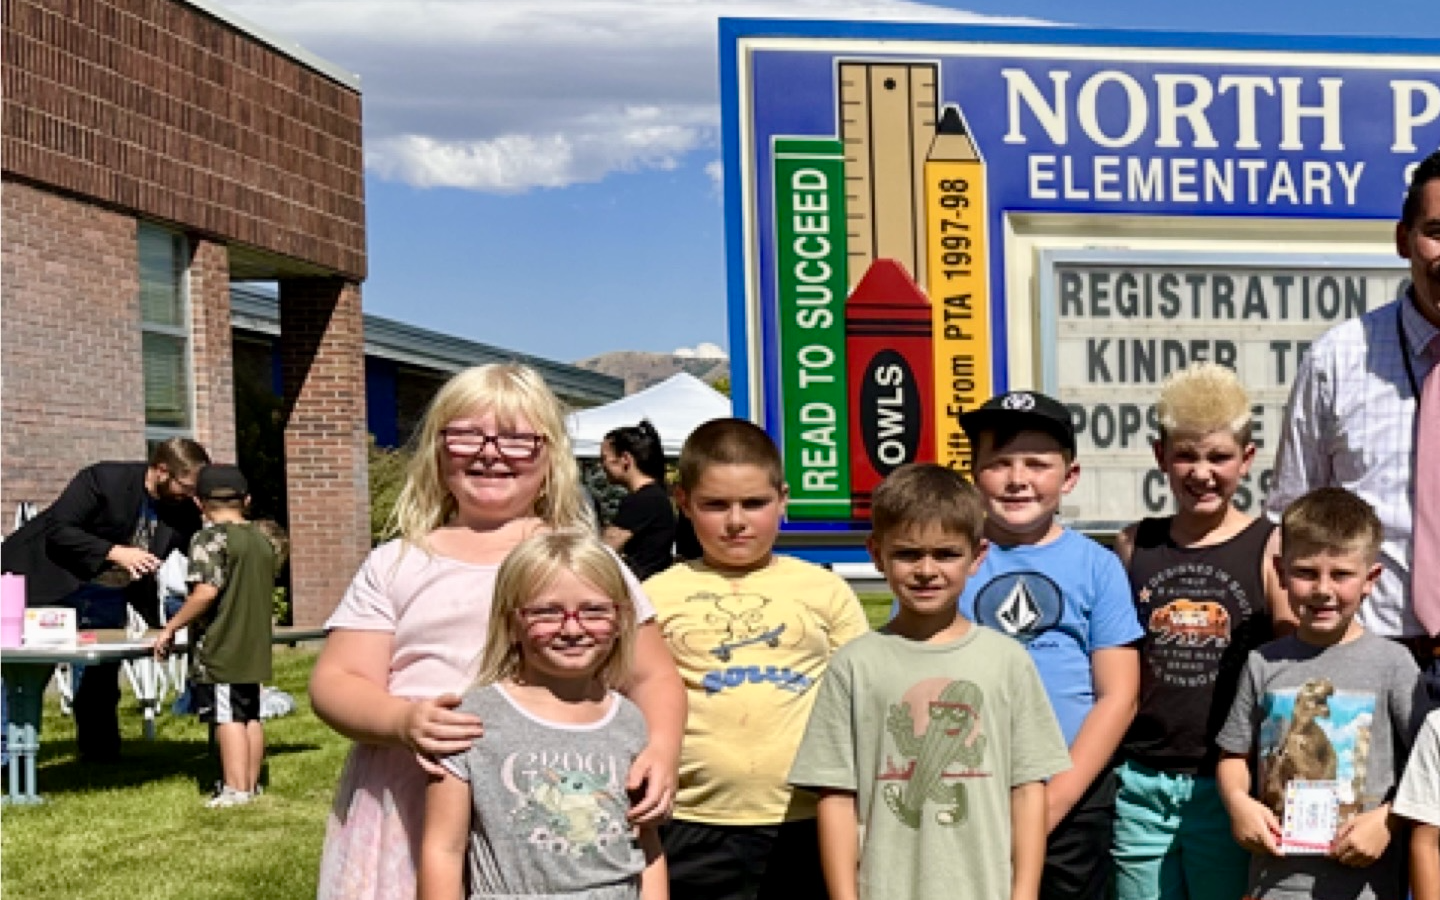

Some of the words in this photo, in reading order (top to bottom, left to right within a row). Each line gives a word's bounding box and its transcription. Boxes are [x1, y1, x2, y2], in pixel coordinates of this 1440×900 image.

[1002, 68, 1344, 151] NORTH
[1029, 155, 1365, 206] ELEMENTARY
[791, 167, 834, 329] SUCCEED
[938, 178, 973, 280] 1997-98
[943, 293, 973, 340] PTA
[1060, 273, 1367, 320] REGISTRATION
[798, 344, 836, 389] TO
[800, 402, 839, 491] READ
[875, 363, 906, 466] OWLS
